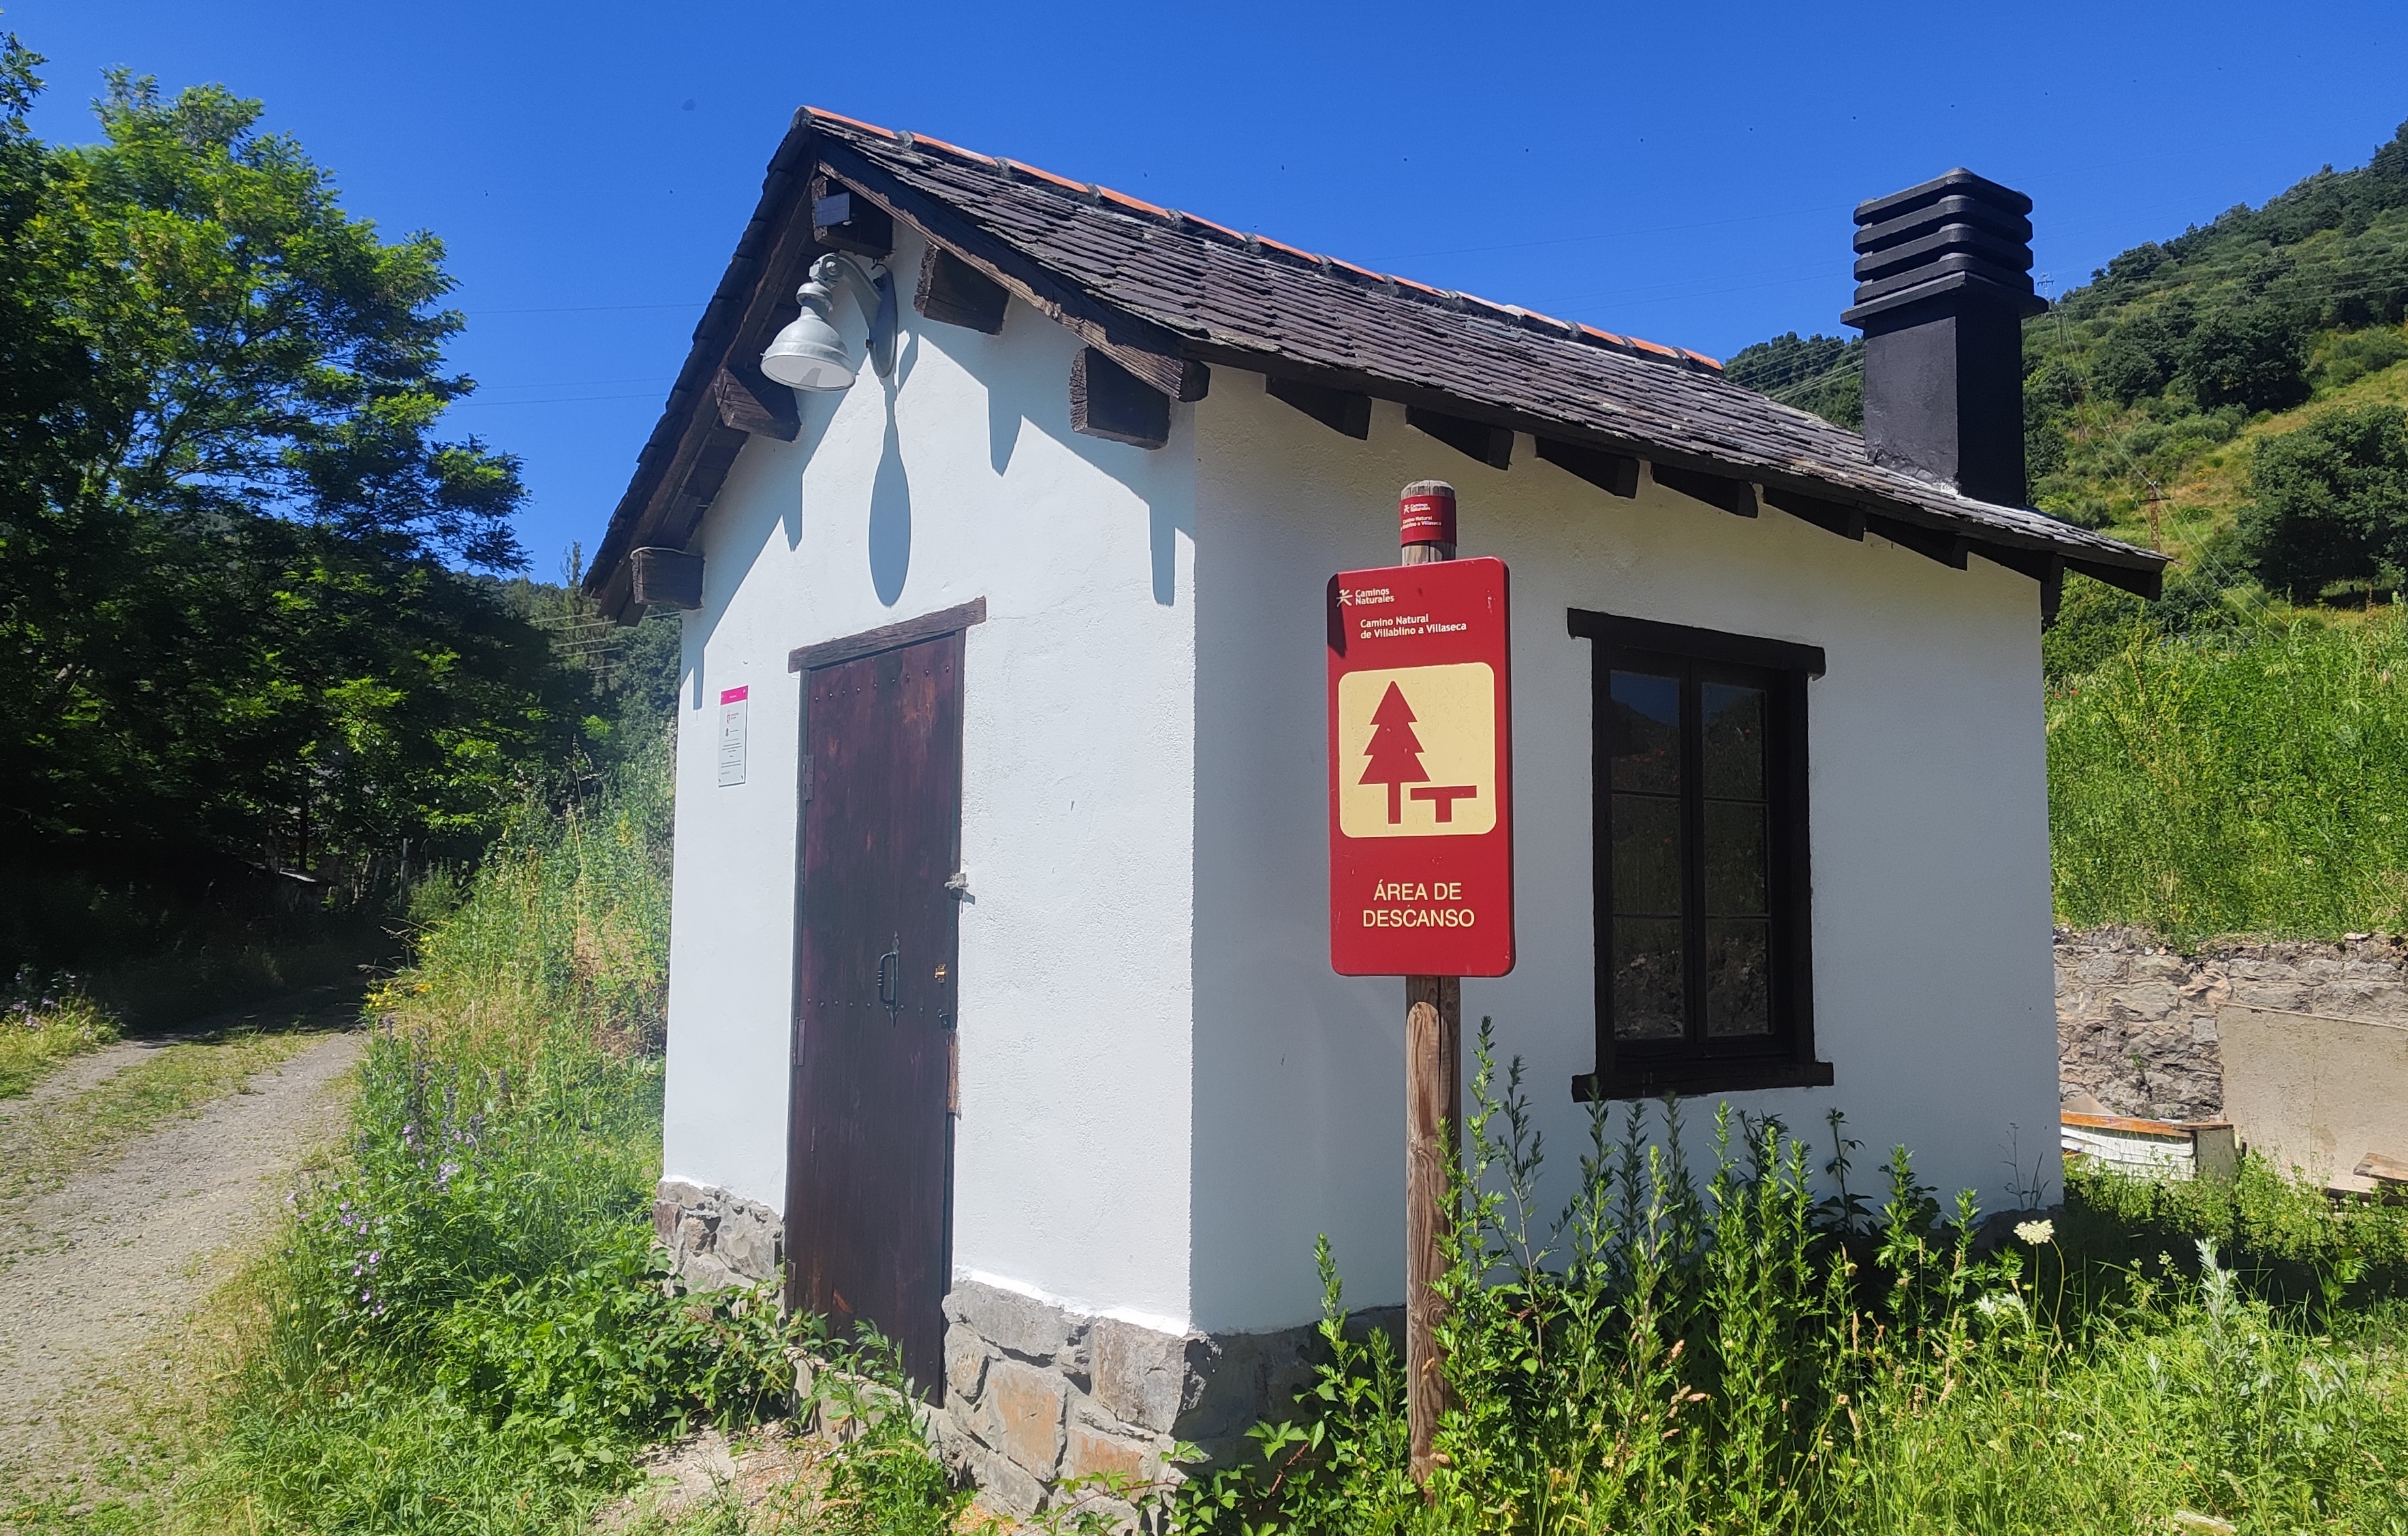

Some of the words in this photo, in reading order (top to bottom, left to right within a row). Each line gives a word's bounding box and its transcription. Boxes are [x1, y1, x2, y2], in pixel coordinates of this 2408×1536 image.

[1355, 588, 1390, 597] Caminos
[1355, 595, 1394, 605] Naturales
[1360, 618, 1394, 628] Camino
[1396, 614, 1429, 625] Natural
[1360, 629, 1372, 639] de
[1373, 625, 1416, 638] Villablino
[1426, 622, 1467, 633] Villaseca
[1373, 879, 1428, 900] ÁREA
[1434, 882, 1462, 900] DE
[1362, 909, 1475, 927] DESCANSO
